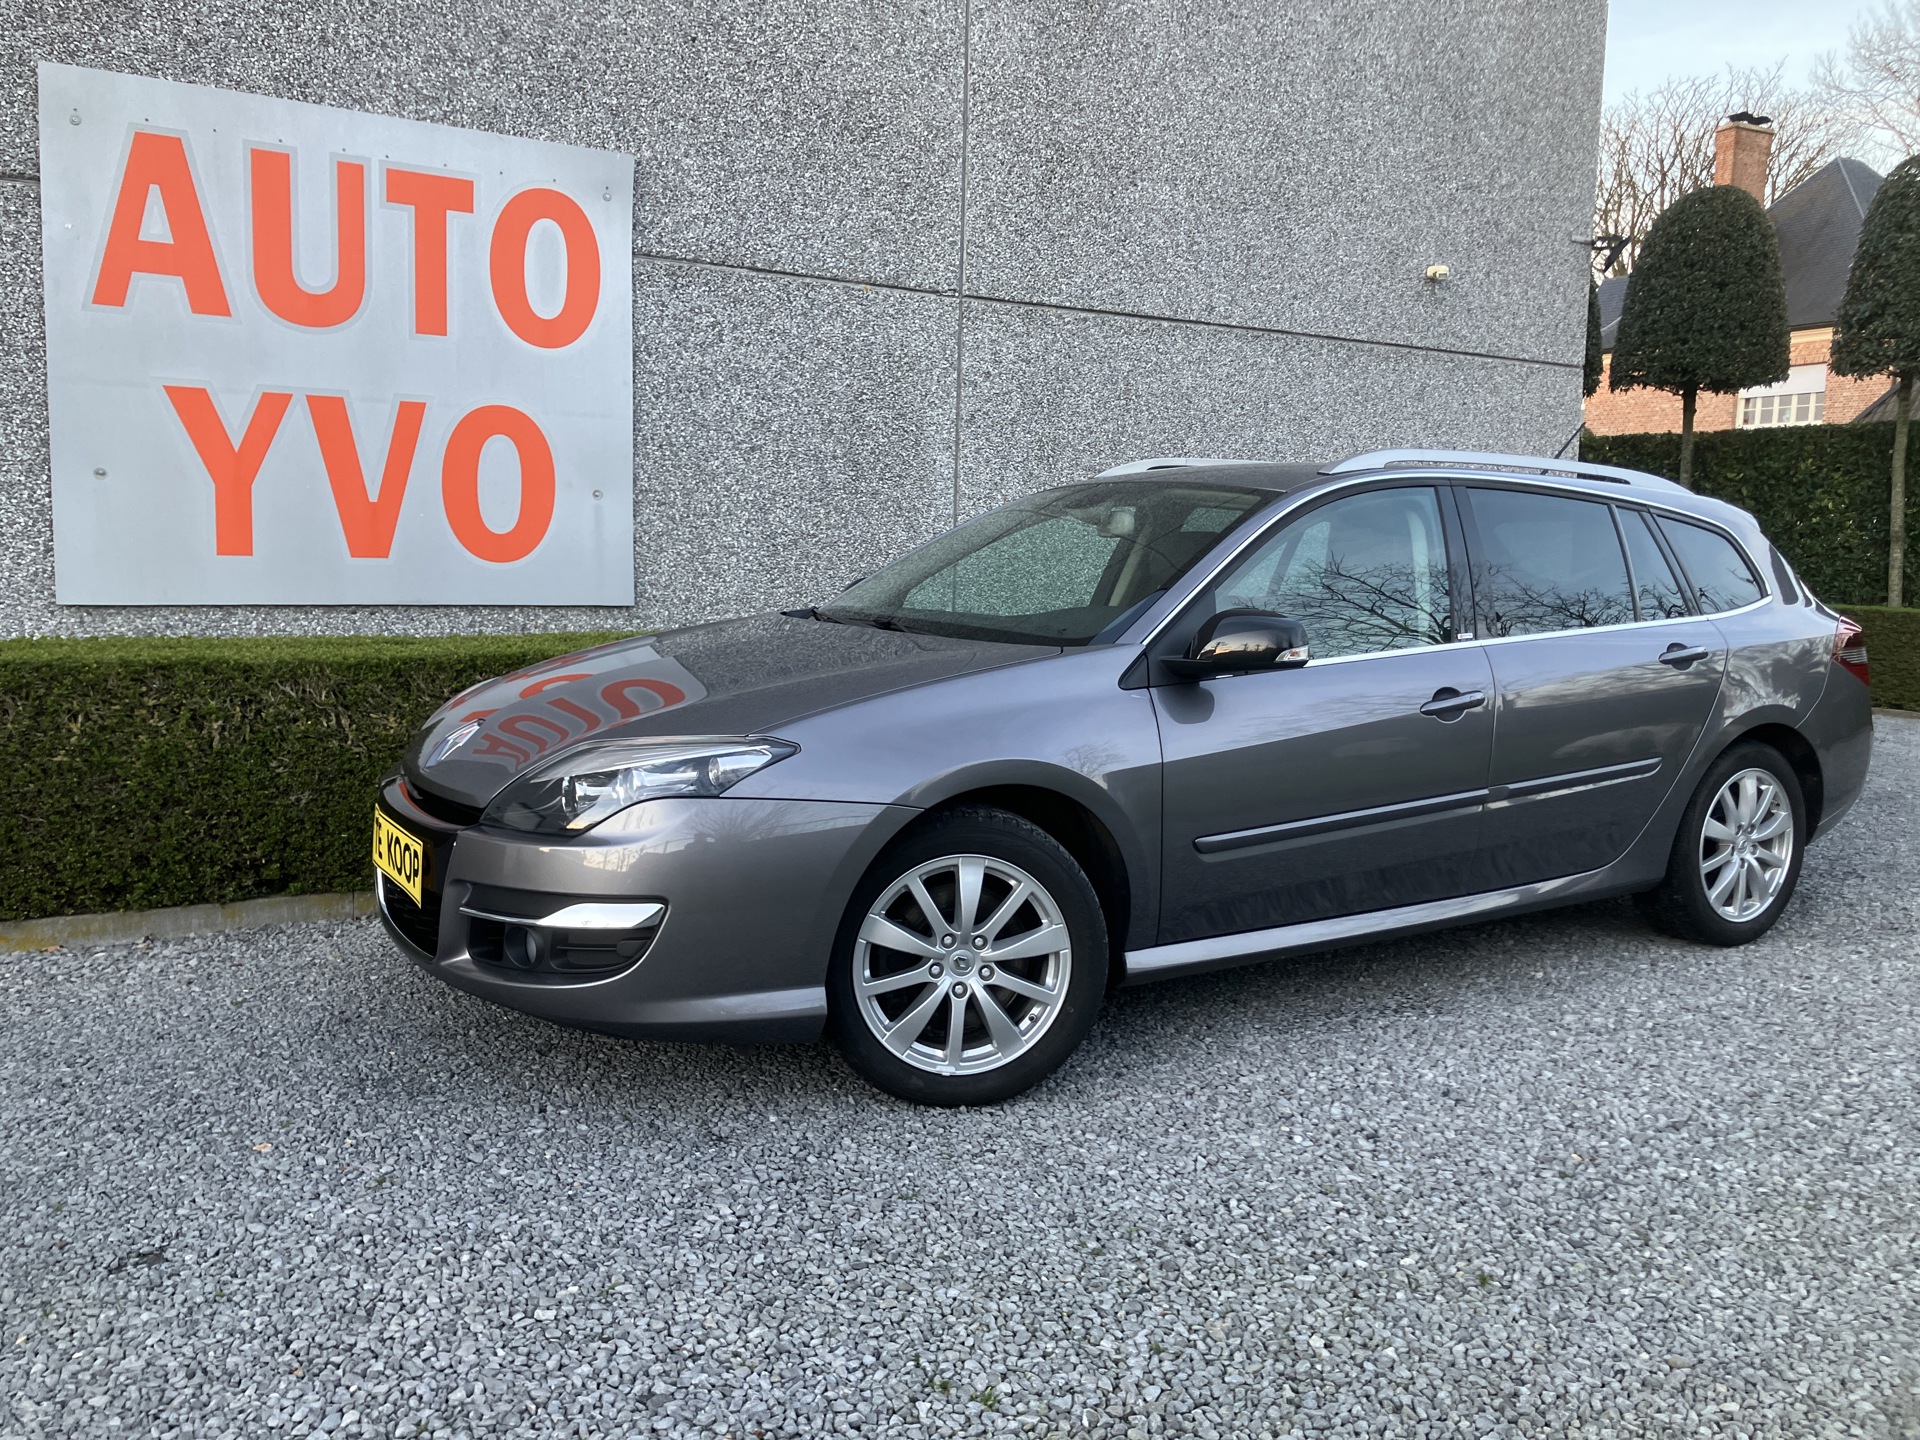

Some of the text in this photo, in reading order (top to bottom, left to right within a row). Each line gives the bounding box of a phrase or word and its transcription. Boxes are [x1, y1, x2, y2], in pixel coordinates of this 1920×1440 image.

[92, 131, 600, 348] AUTO
[163, 385, 556, 563] YVO
[387, 829, 420, 889] KOOP
